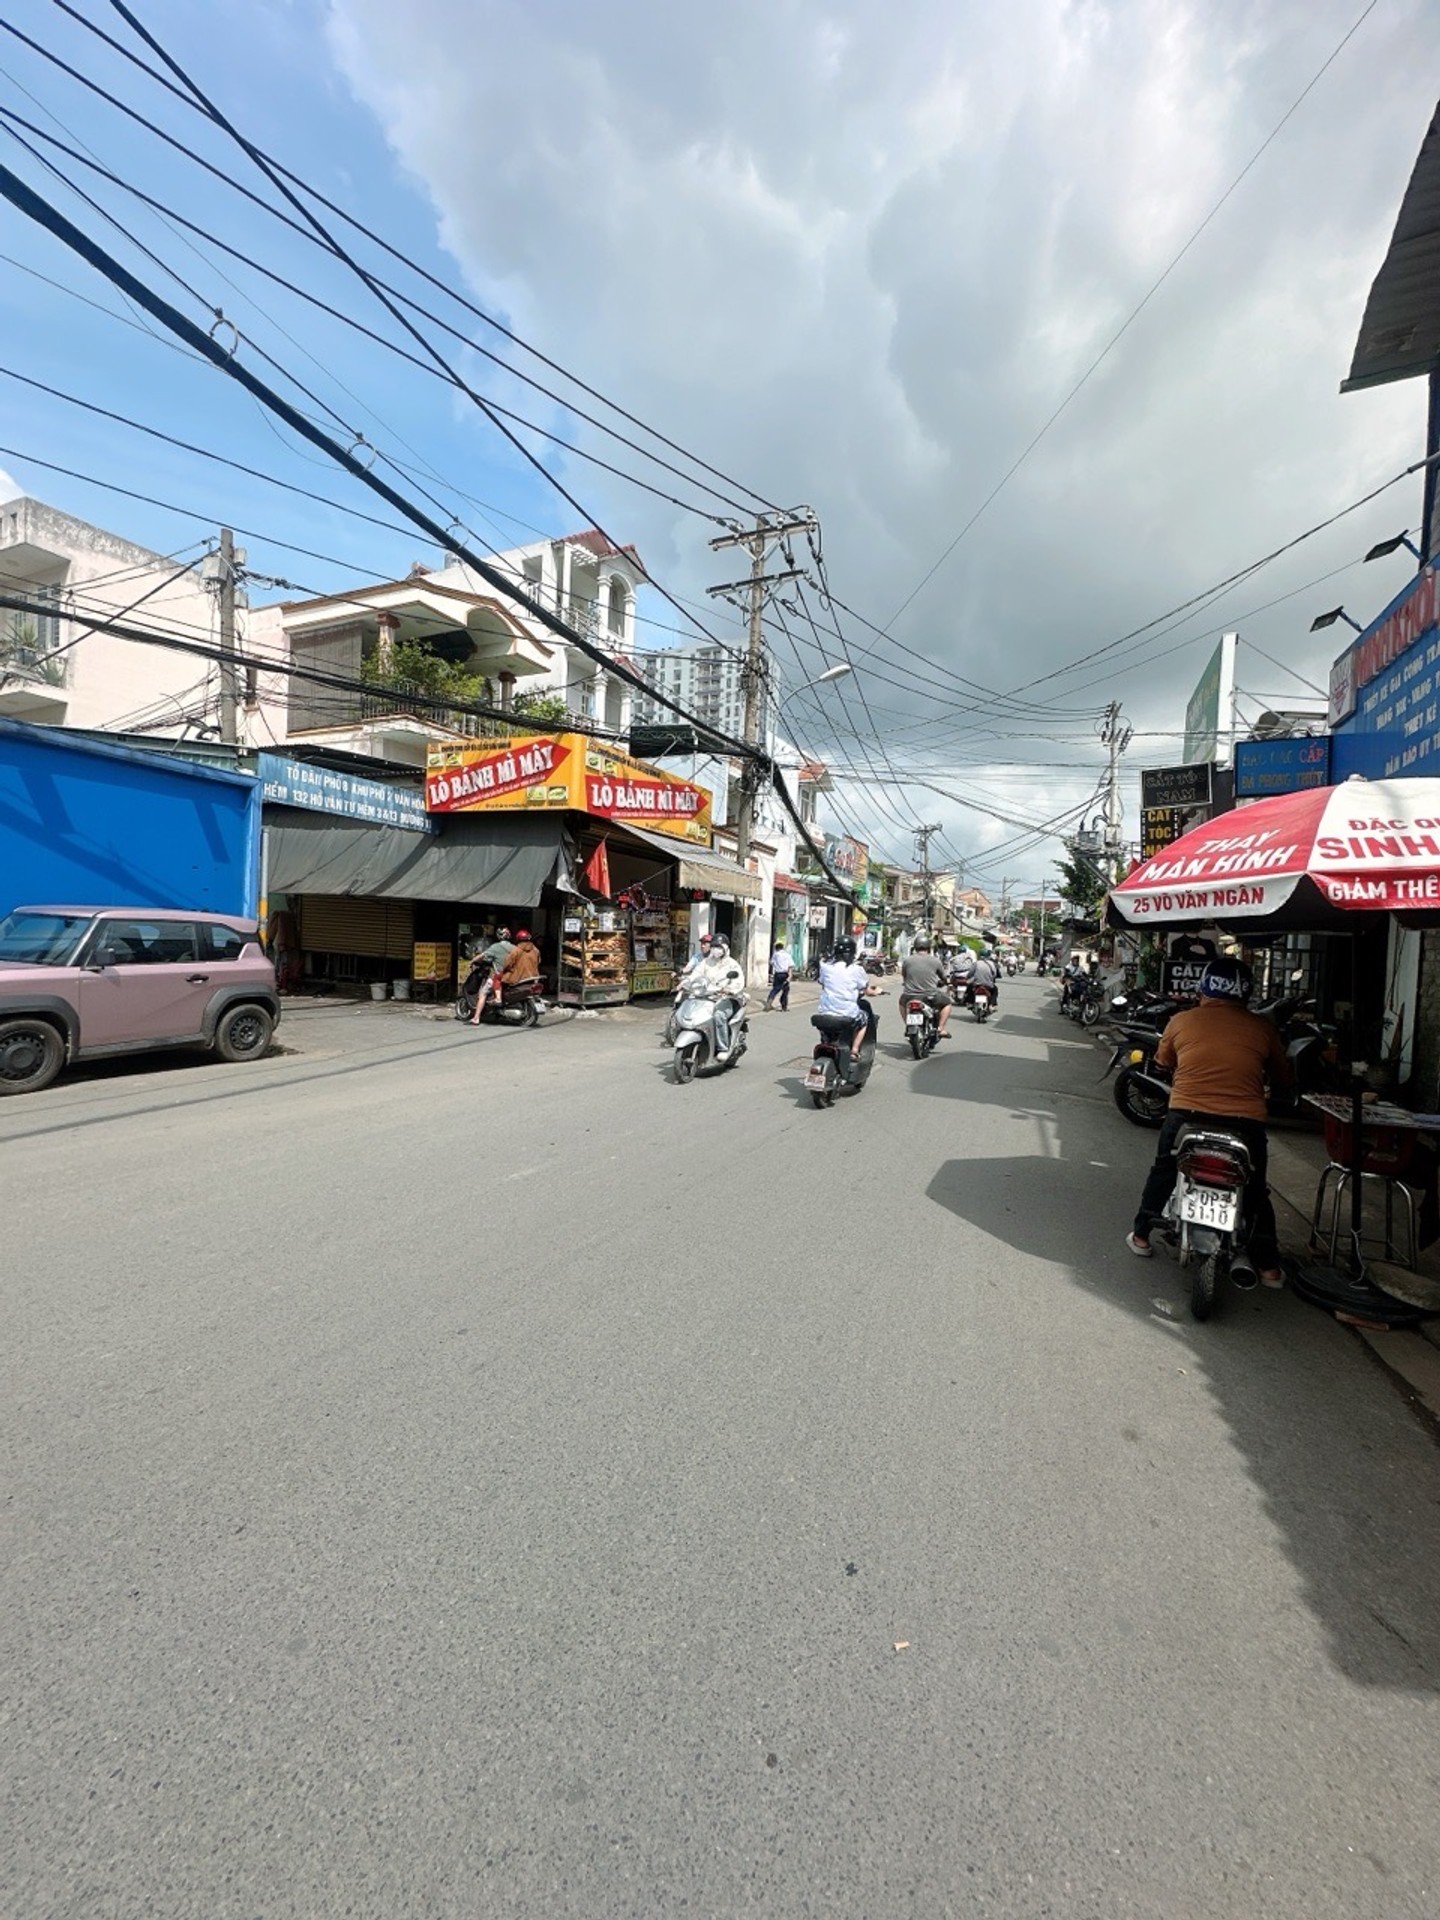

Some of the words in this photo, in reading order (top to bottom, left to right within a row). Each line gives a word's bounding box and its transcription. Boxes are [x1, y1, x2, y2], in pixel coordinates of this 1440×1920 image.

[286, 762, 300, 780] TỔ
[324, 774, 341, 790] PHỐ
[429, 776, 450, 805] LÒ
[450, 767, 496, 798] BÁNH
[496, 752, 518, 784] MÌ
[519, 744, 554, 776] MÂY
[264, 780, 288, 799] HẺM
[292, 790, 308, 804] 132
[310, 790, 323, 806] HỒ
[591, 778, 613, 808] LÒ
[615, 780, 656, 810] BÁNH
[657, 784, 674, 810] MÌ
[675, 786, 700, 812] MÂY
[1157, 788, 1196, 804] NAM
[1148, 826, 1172, 840] TÓC
[1348, 818, 1408, 833] ĐẶC
[1196, 829, 1282, 854] THAY
[1316, 834, 1440, 859] SINH
[1138, 856, 1204, 882] MÀN
[1210, 845, 1297, 874] HÌNH
[1134, 898, 1150, 913] 25
[1154, 893, 1172, 911] VÕ
[1176, 890, 1208, 908] VĂN
[1213, 885, 1264, 907] NGÂN
[1328, 876, 1388, 900] GIẢM
